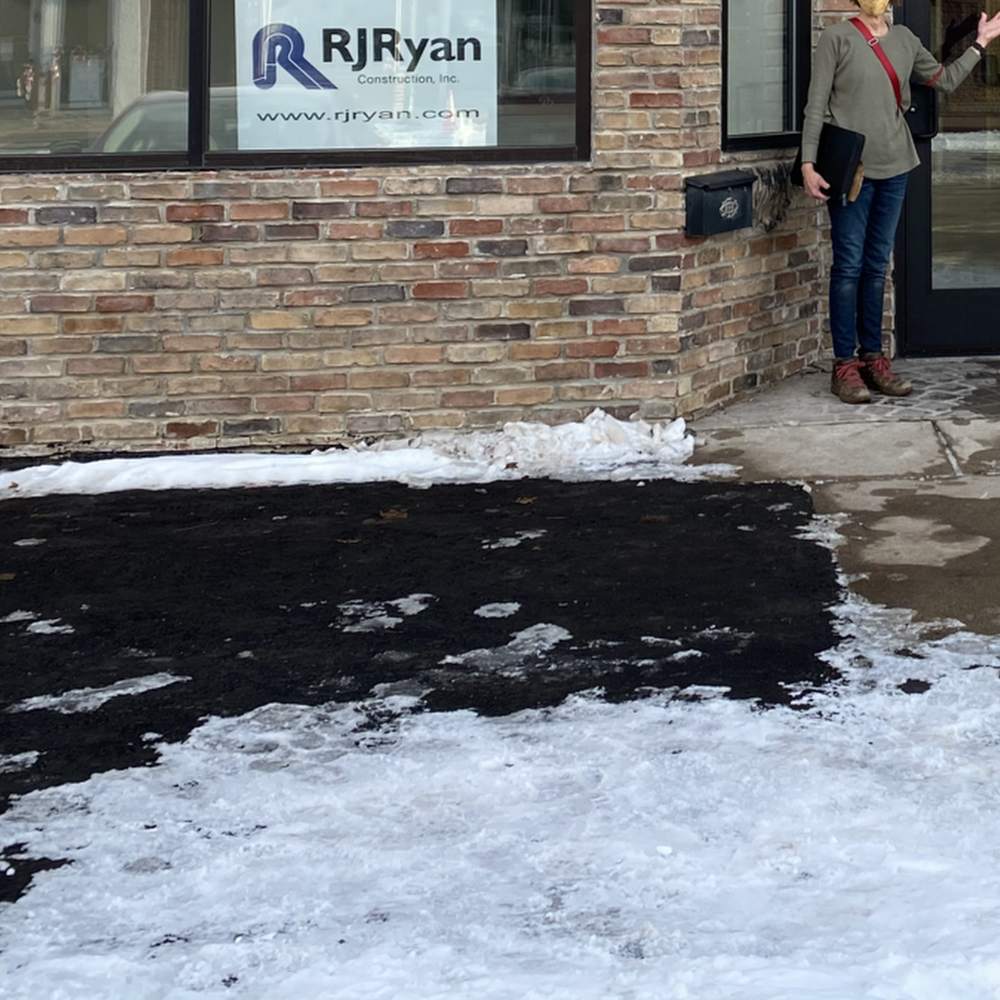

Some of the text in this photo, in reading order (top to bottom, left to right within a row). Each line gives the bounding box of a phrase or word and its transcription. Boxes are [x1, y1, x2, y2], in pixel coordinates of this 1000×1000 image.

[322, 28, 482, 72] RJRyan
[357, 74, 460, 84] Construction, Inc.
[256, 108, 480, 123] www.rjryan.com
